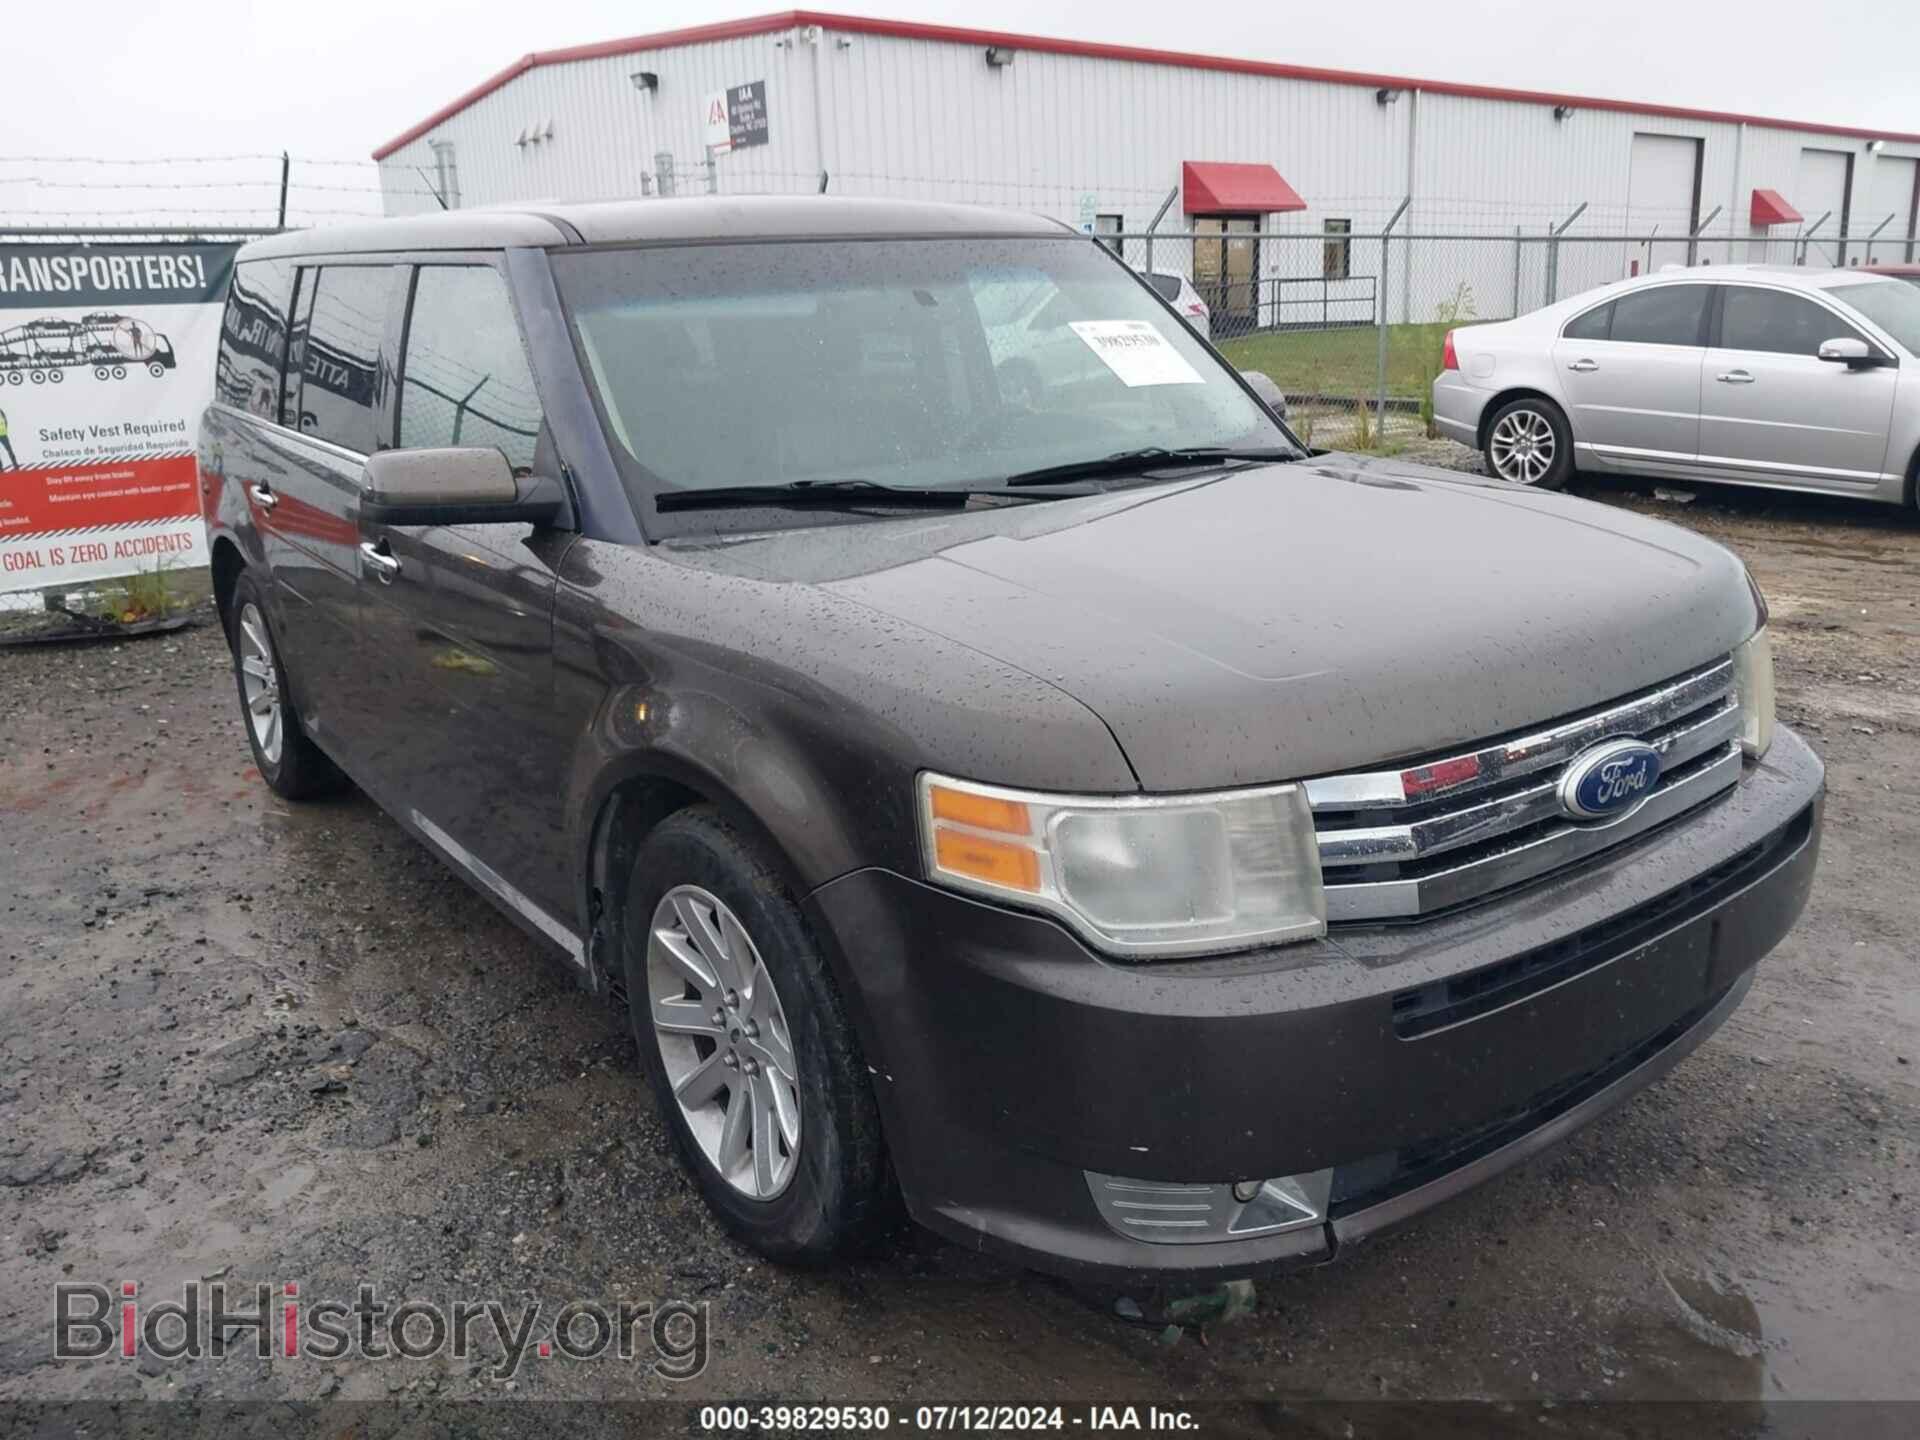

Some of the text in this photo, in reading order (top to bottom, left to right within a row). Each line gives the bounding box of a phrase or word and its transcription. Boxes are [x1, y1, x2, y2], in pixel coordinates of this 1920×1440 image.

[40, 419, 186, 442] Safety Vest Required
[43, 446, 82, 458] Chaleco
[84, 446, 95, 456] de
[97, 441, 143, 454] Seguridad
[3, 532, 193, 572] GOAL IS ZERO ACCIDENTS
[1598, 756, 1648, 803] Ford
